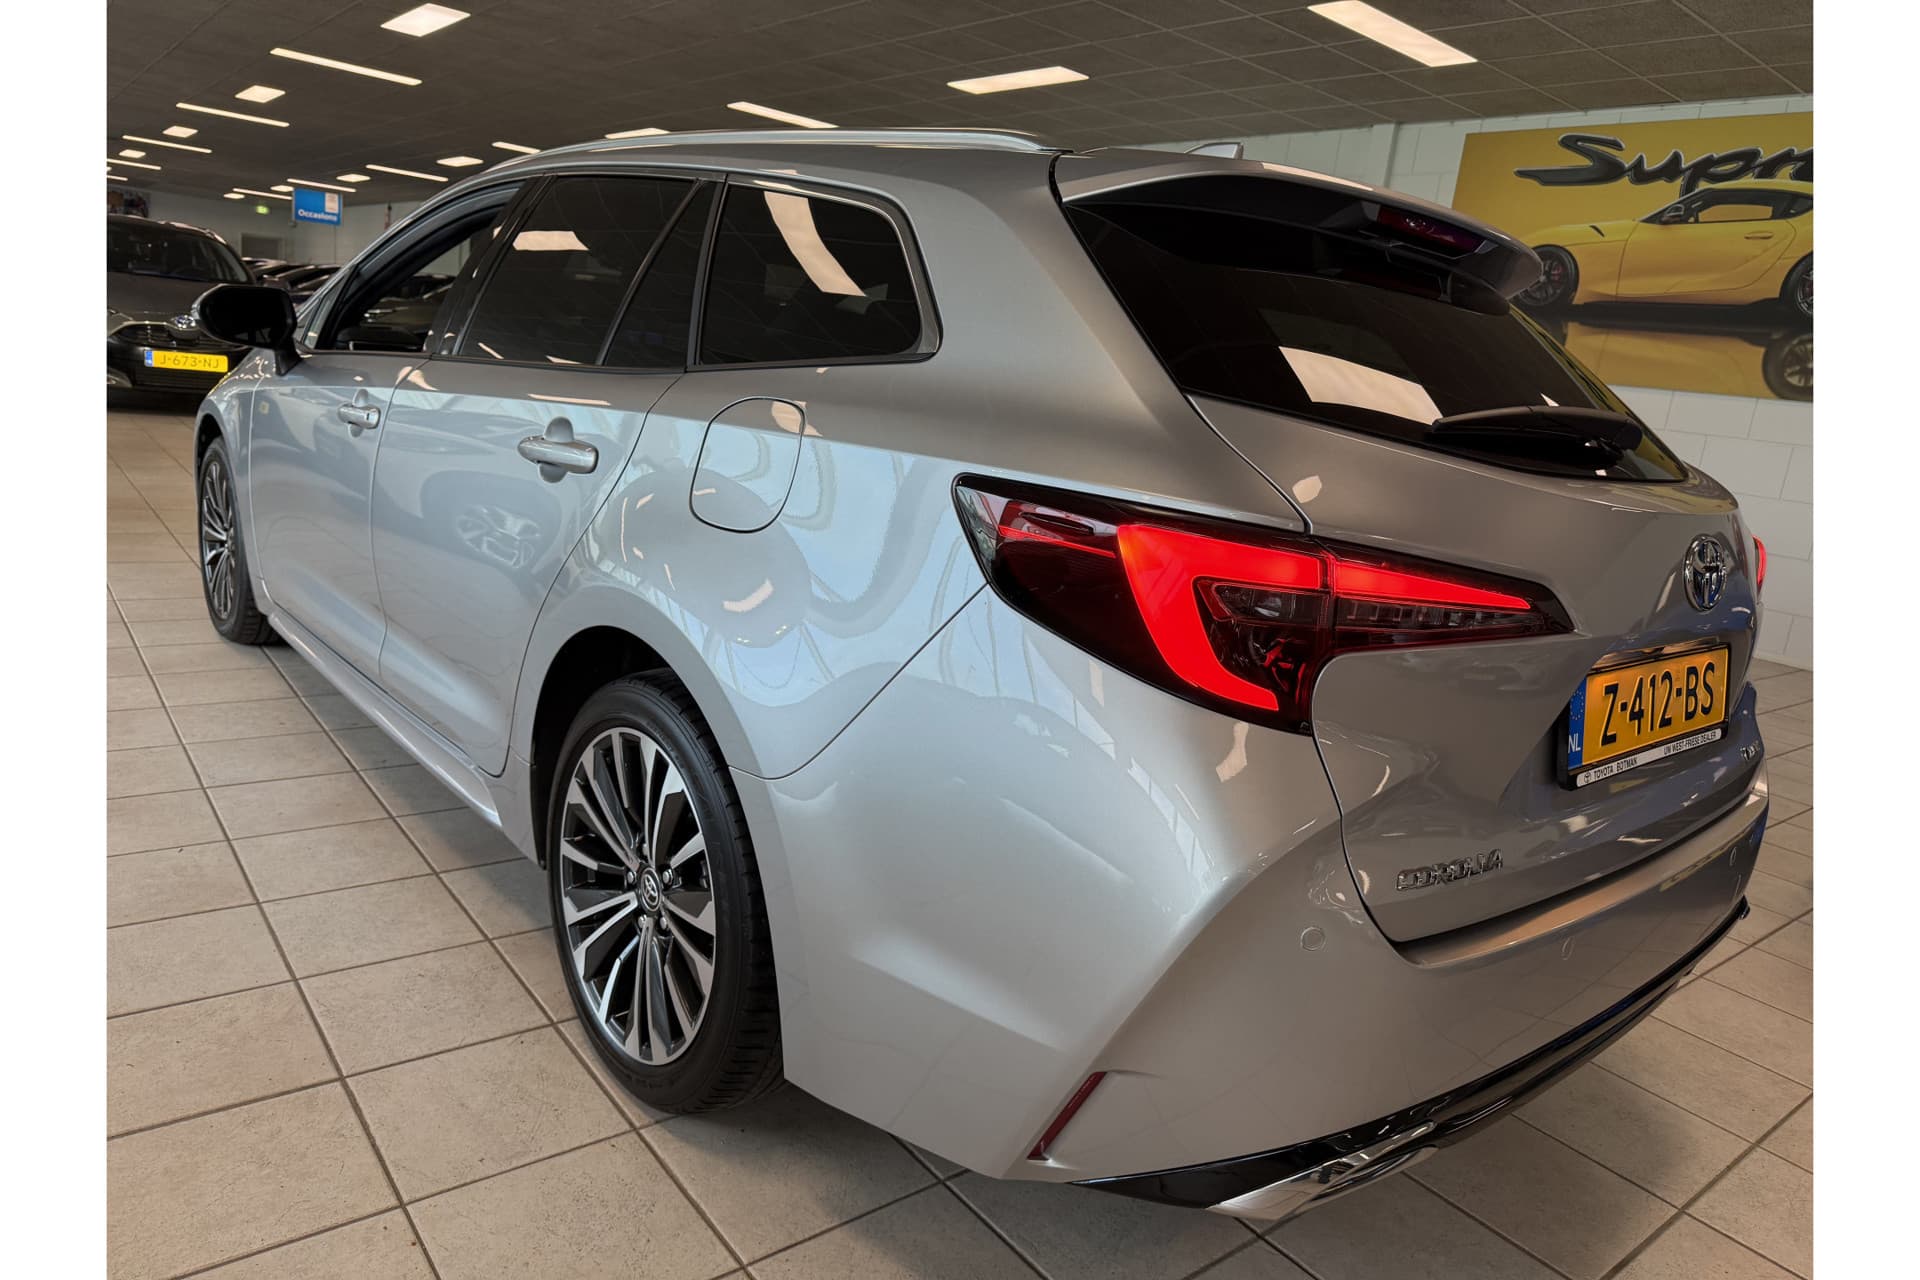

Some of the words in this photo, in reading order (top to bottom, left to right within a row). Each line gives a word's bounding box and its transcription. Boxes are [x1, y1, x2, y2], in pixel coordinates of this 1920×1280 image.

[298, 208, 338, 222] Occasions
[160, 354, 220, 369] J-673-NJ
[1600, 661, 1715, 747] Z-412-BS
[1567, 733, 1581, 754] NL
[1593, 765, 1614, 781] TOYOTA
[1616, 757, 1638, 772] BOTMAN
[1700, 731, 1717, 745] DEALER
